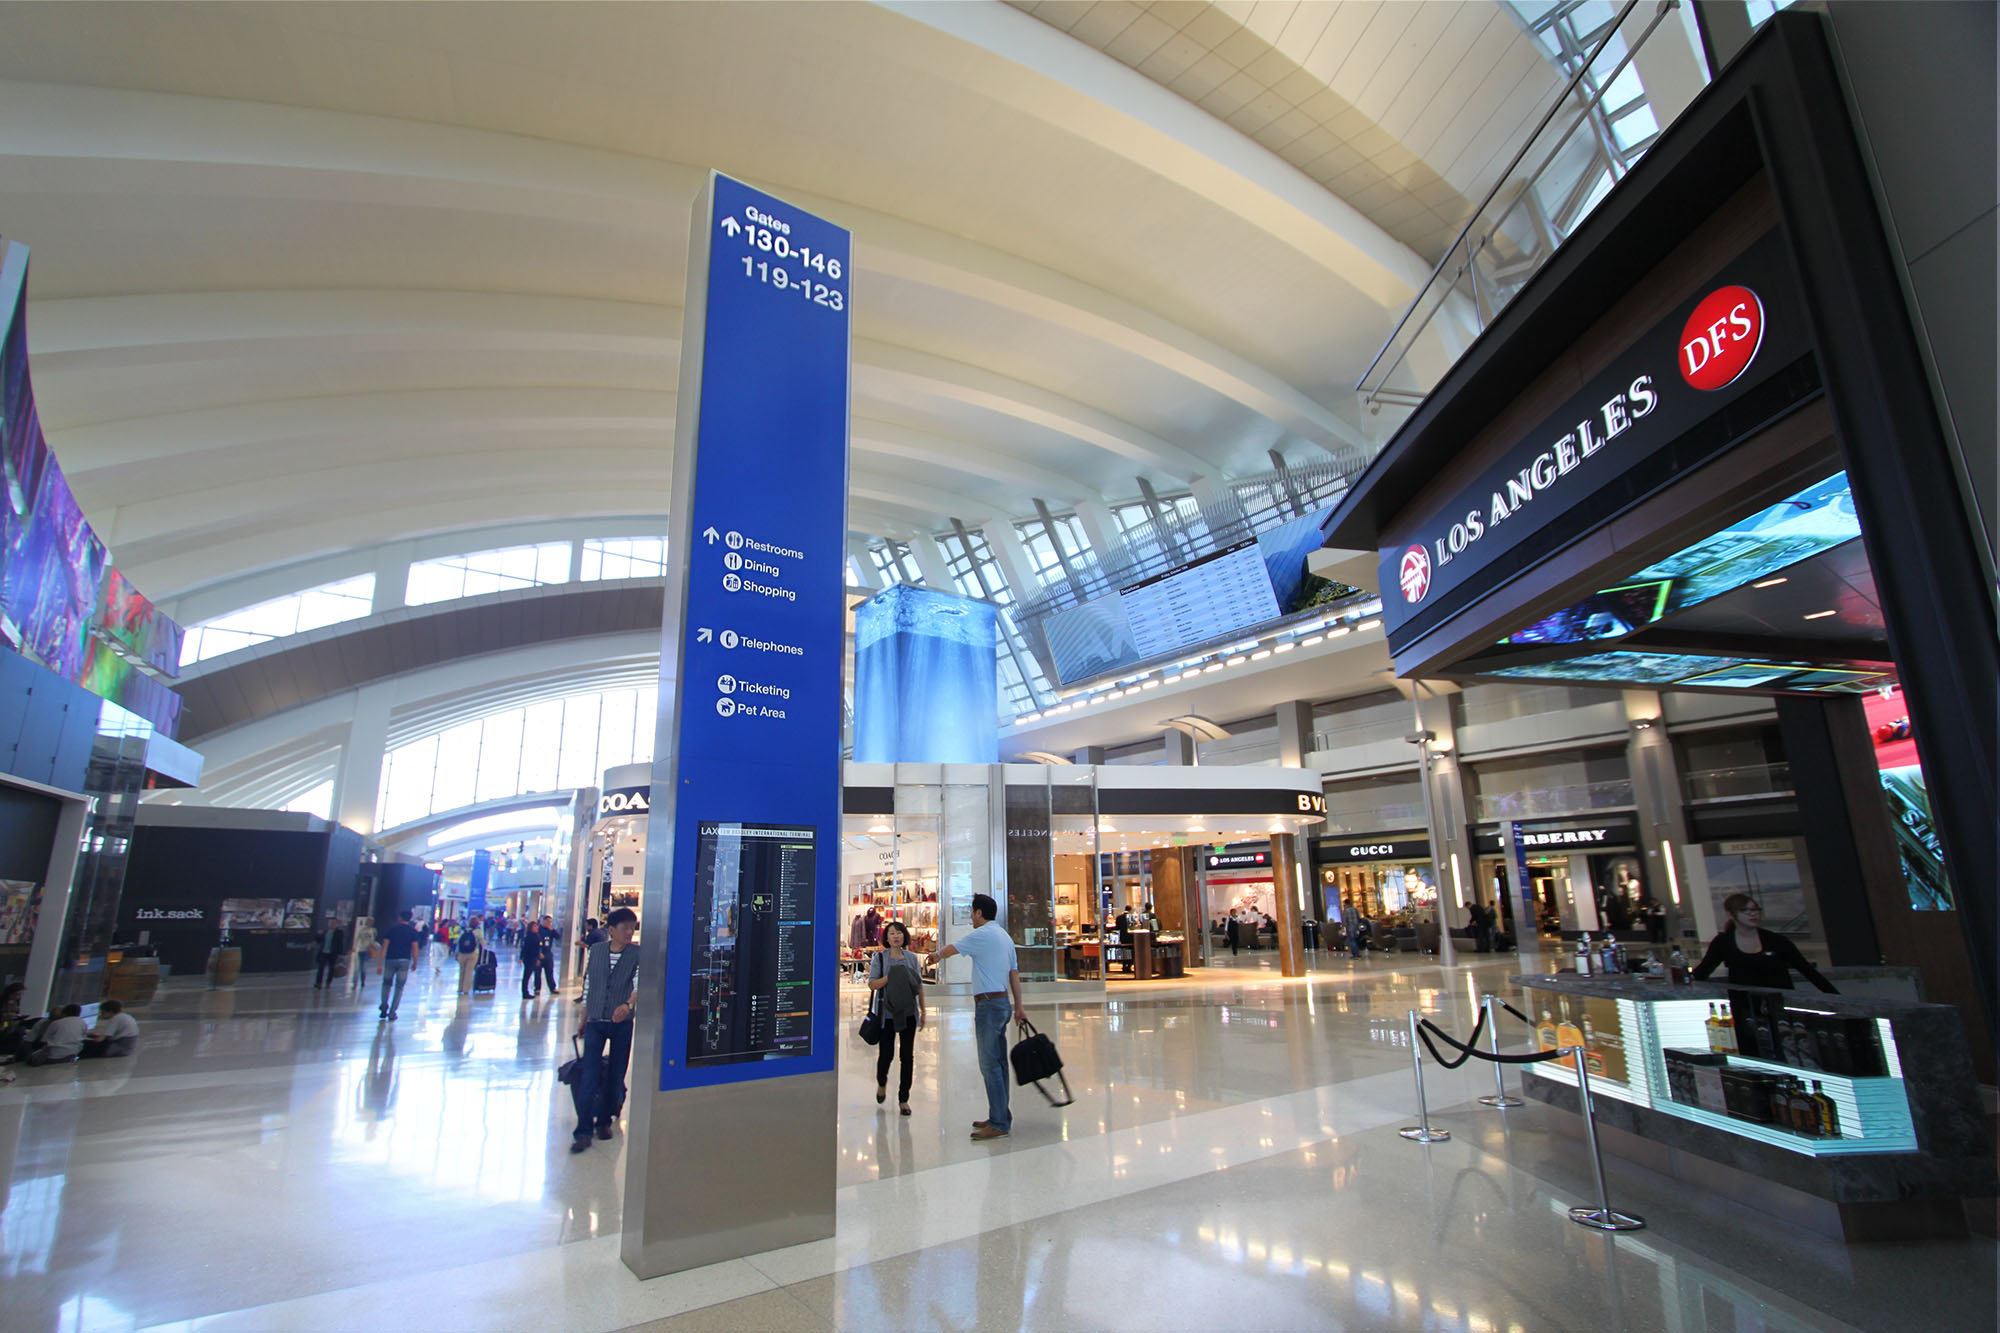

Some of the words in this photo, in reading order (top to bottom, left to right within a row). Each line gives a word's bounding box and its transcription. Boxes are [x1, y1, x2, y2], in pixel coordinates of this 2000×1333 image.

[745, 205, 791, 235] Gates
[744, 224, 842, 280] 130-146
[741, 256, 844, 311] 119-123
[1682, 302, 1754, 376] DFS
[1435, 509, 1485, 567] LOS
[1489, 375, 1659, 528] ANGELES
[745, 537, 804, 560] Restrooms
[744, 559, 780, 577] Dining
[743, 580, 796, 601] Shopping
[740, 636, 804, 656] Telephones
[738, 680, 790, 700] Ticketing
[737, 703, 758, 717] Pet
[759, 707, 786, 720] Area
[600, 792, 651, 813] COA
[1297, 794, 1328, 813] BVL
[701, 827, 719, 836] LAX
[1498, 829, 1607, 847] RBERRY
[1231, 855, 1254, 863] ANGELES
[1350, 845, 1394, 857] GUCCI
[135, 908, 204, 919] ink.sack
